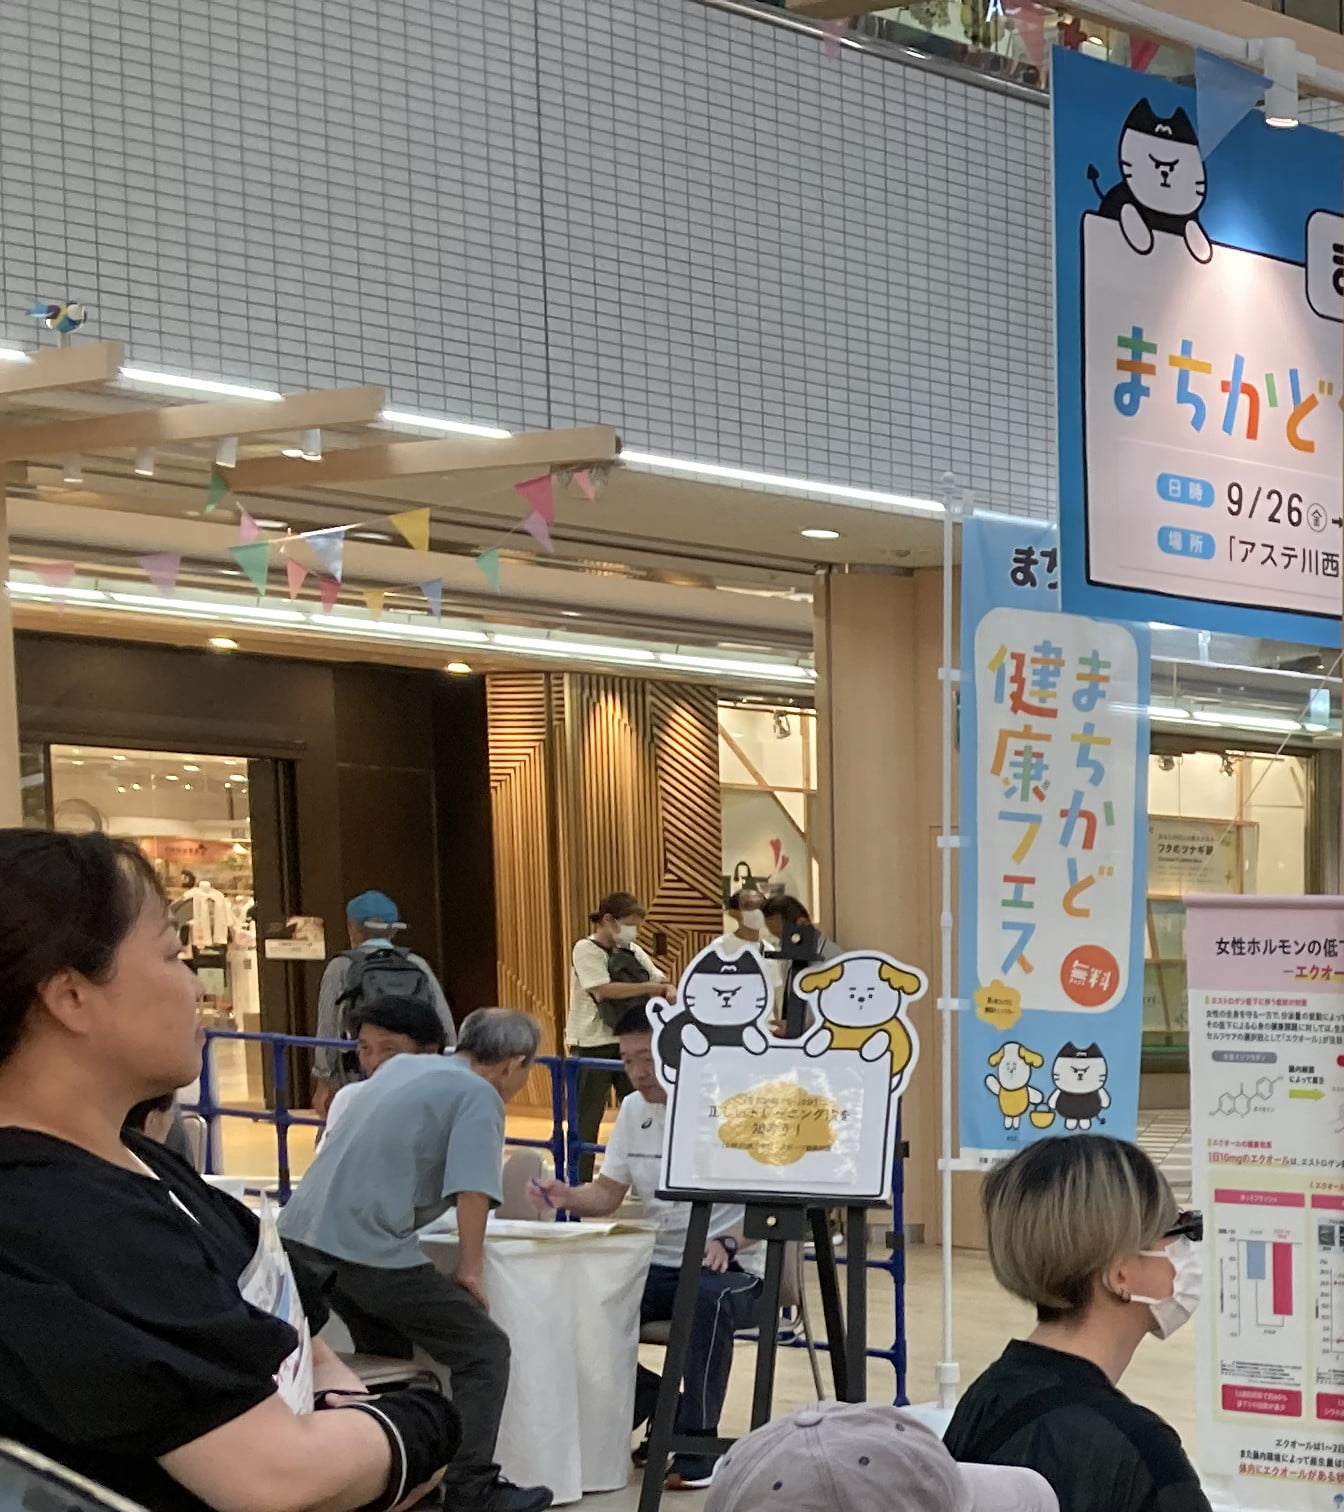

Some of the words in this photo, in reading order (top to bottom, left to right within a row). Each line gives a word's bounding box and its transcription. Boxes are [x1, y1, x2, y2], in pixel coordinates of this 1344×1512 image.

[1167, 477, 1206, 503] 日時
[1168, 529, 1204, 555] 場所
[986, 638, 1066, 976] 健康フェス
[1058, 648, 1114, 919] まちかど
